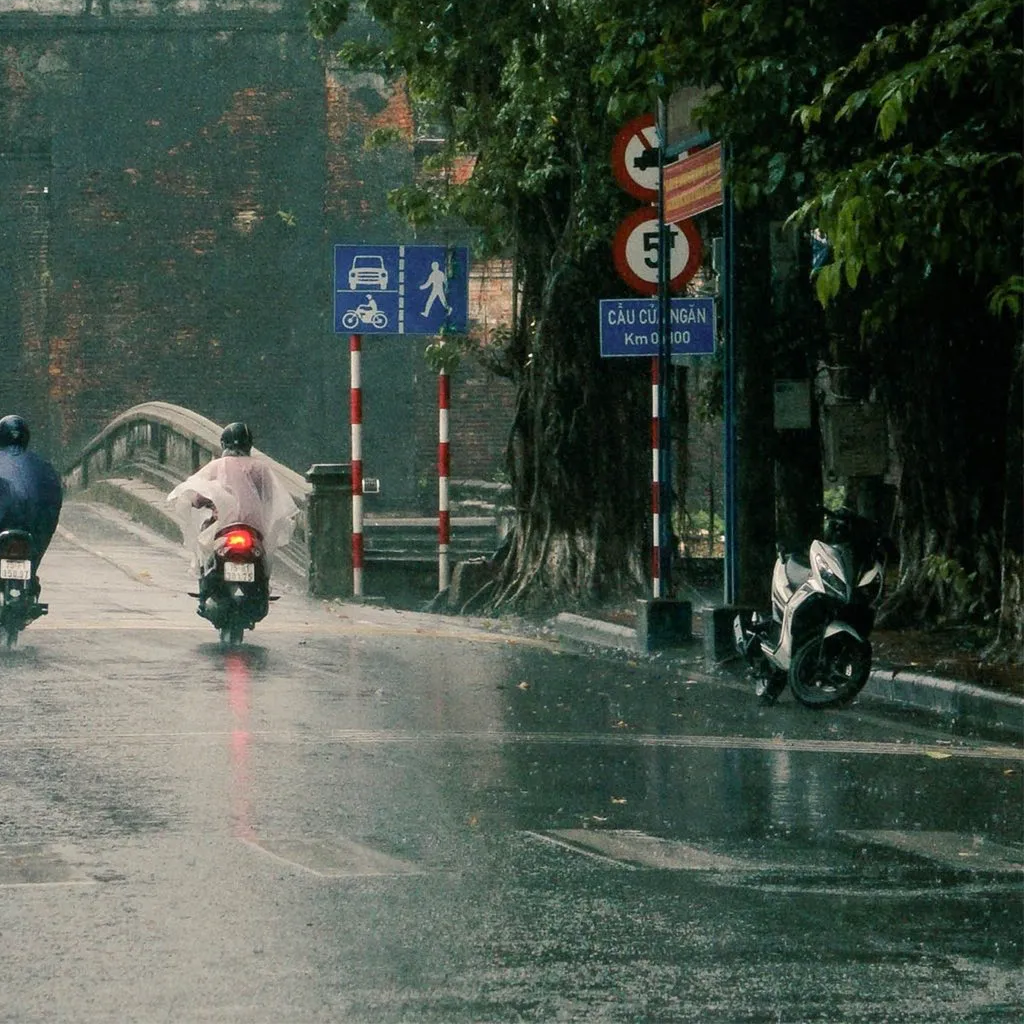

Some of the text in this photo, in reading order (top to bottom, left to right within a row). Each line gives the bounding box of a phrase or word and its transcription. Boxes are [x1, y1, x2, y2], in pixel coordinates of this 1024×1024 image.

[608, 302, 635, 325] CẦU
[639, 303, 667, 324] CỬ
[624, 332, 648, 345] Km
